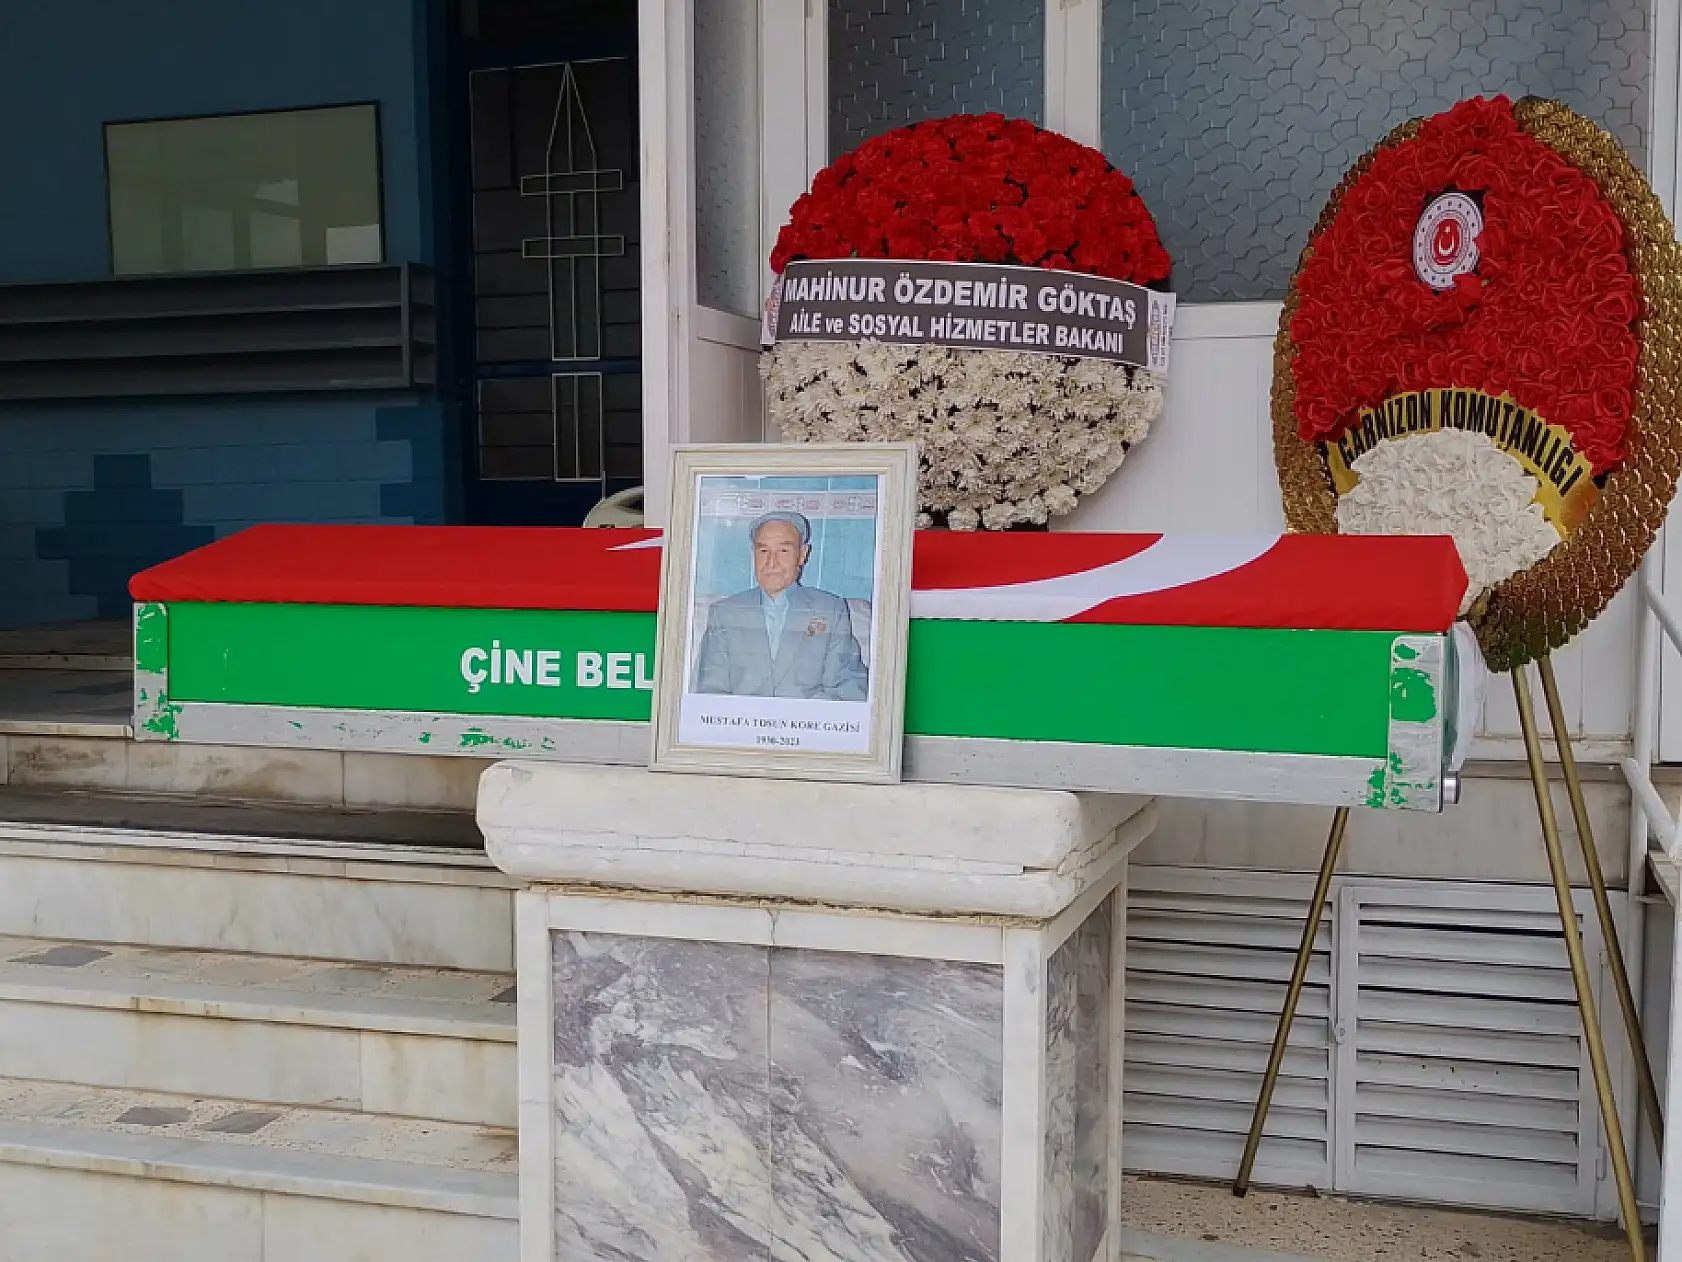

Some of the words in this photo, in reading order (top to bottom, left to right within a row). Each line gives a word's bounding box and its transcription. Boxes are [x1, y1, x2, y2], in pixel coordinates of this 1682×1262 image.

[784, 270, 886, 303] MAHİNUR
[894, 271, 1028, 310] ÖZDEMİR
[1037, 282, 1136, 330] GÖKTAŞ
[789, 307, 822, 334] AİLE
[825, 317, 844, 334] ve
[848, 312, 925, 338] SOSYAL
[930, 312, 1050, 345] HİZMETLER
[1055, 325, 1124, 354] BAKANI
[460, 640, 561, 693] ÇİNE
[576, 652, 656, 690] BEL
[700, 714, 750, 727] MUSTAFA
[790, 720, 821, 731] KORE
